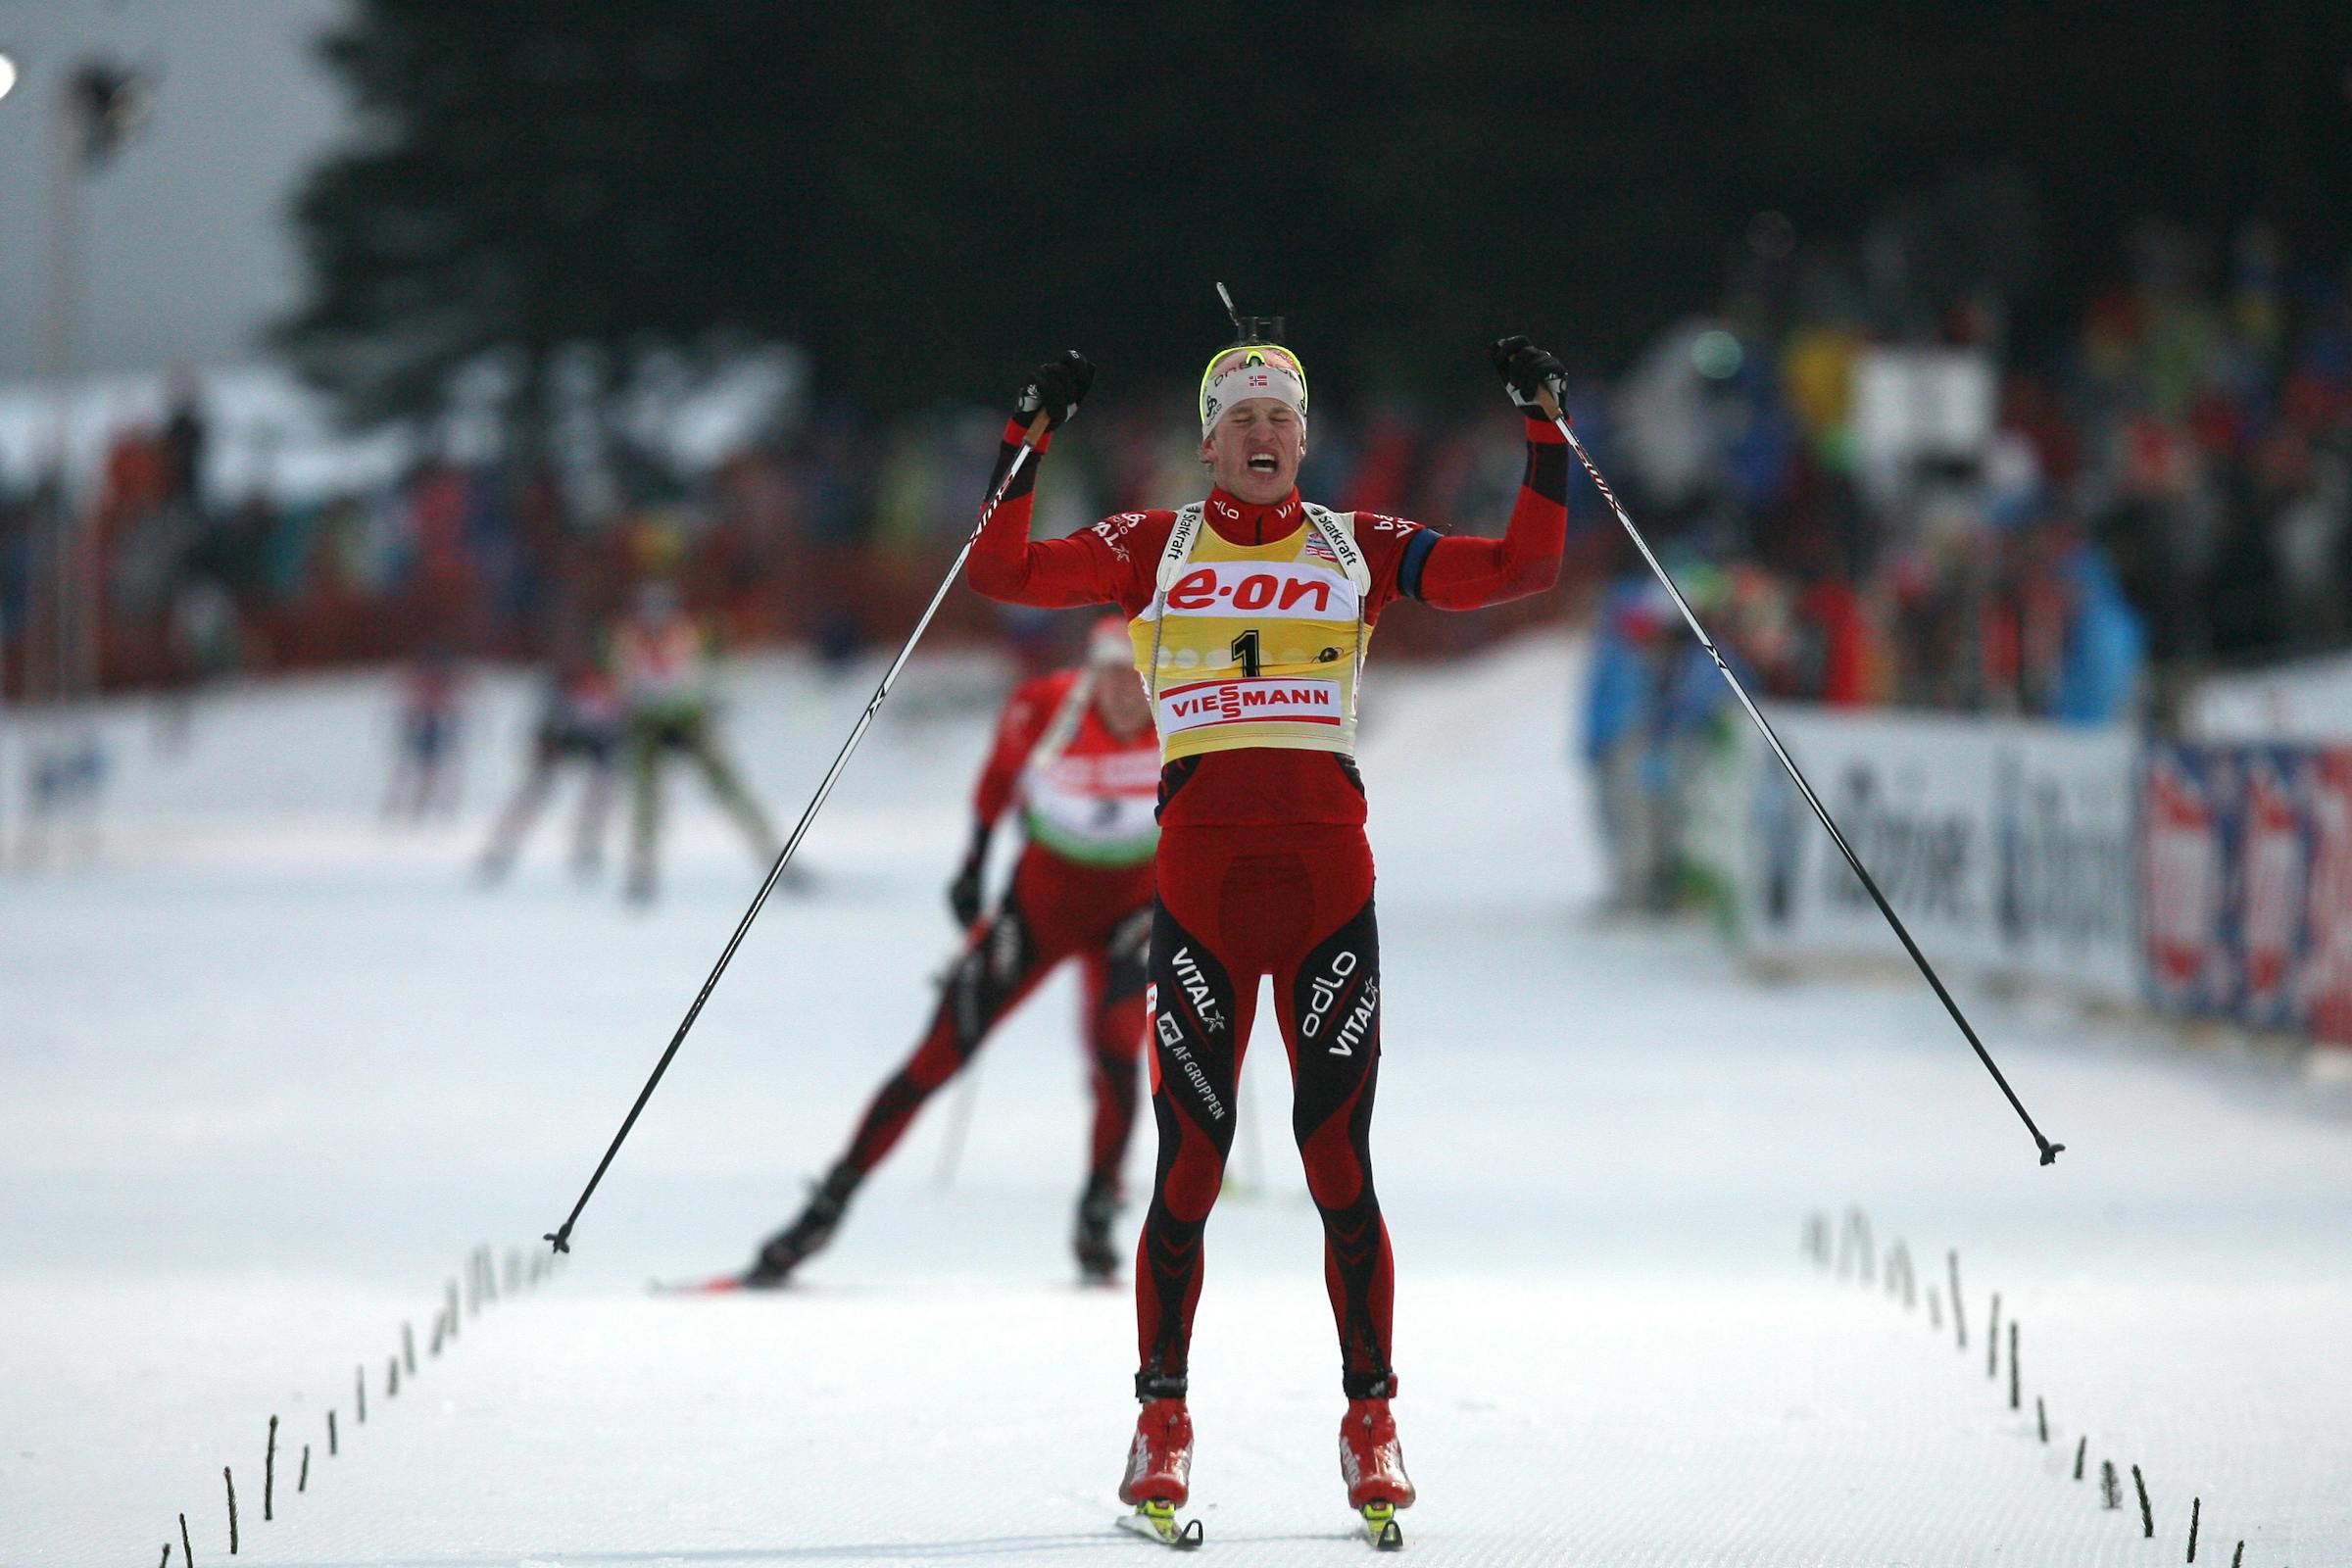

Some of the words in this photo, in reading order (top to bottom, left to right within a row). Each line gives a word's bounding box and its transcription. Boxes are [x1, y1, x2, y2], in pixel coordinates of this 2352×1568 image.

[1167, 513, 1197, 561] Statkraft
[1319, 514, 1357, 565] Statkraft
[1231, 630, 1259, 677] 1
[1172, 686, 1329, 718] VIESSMANN
